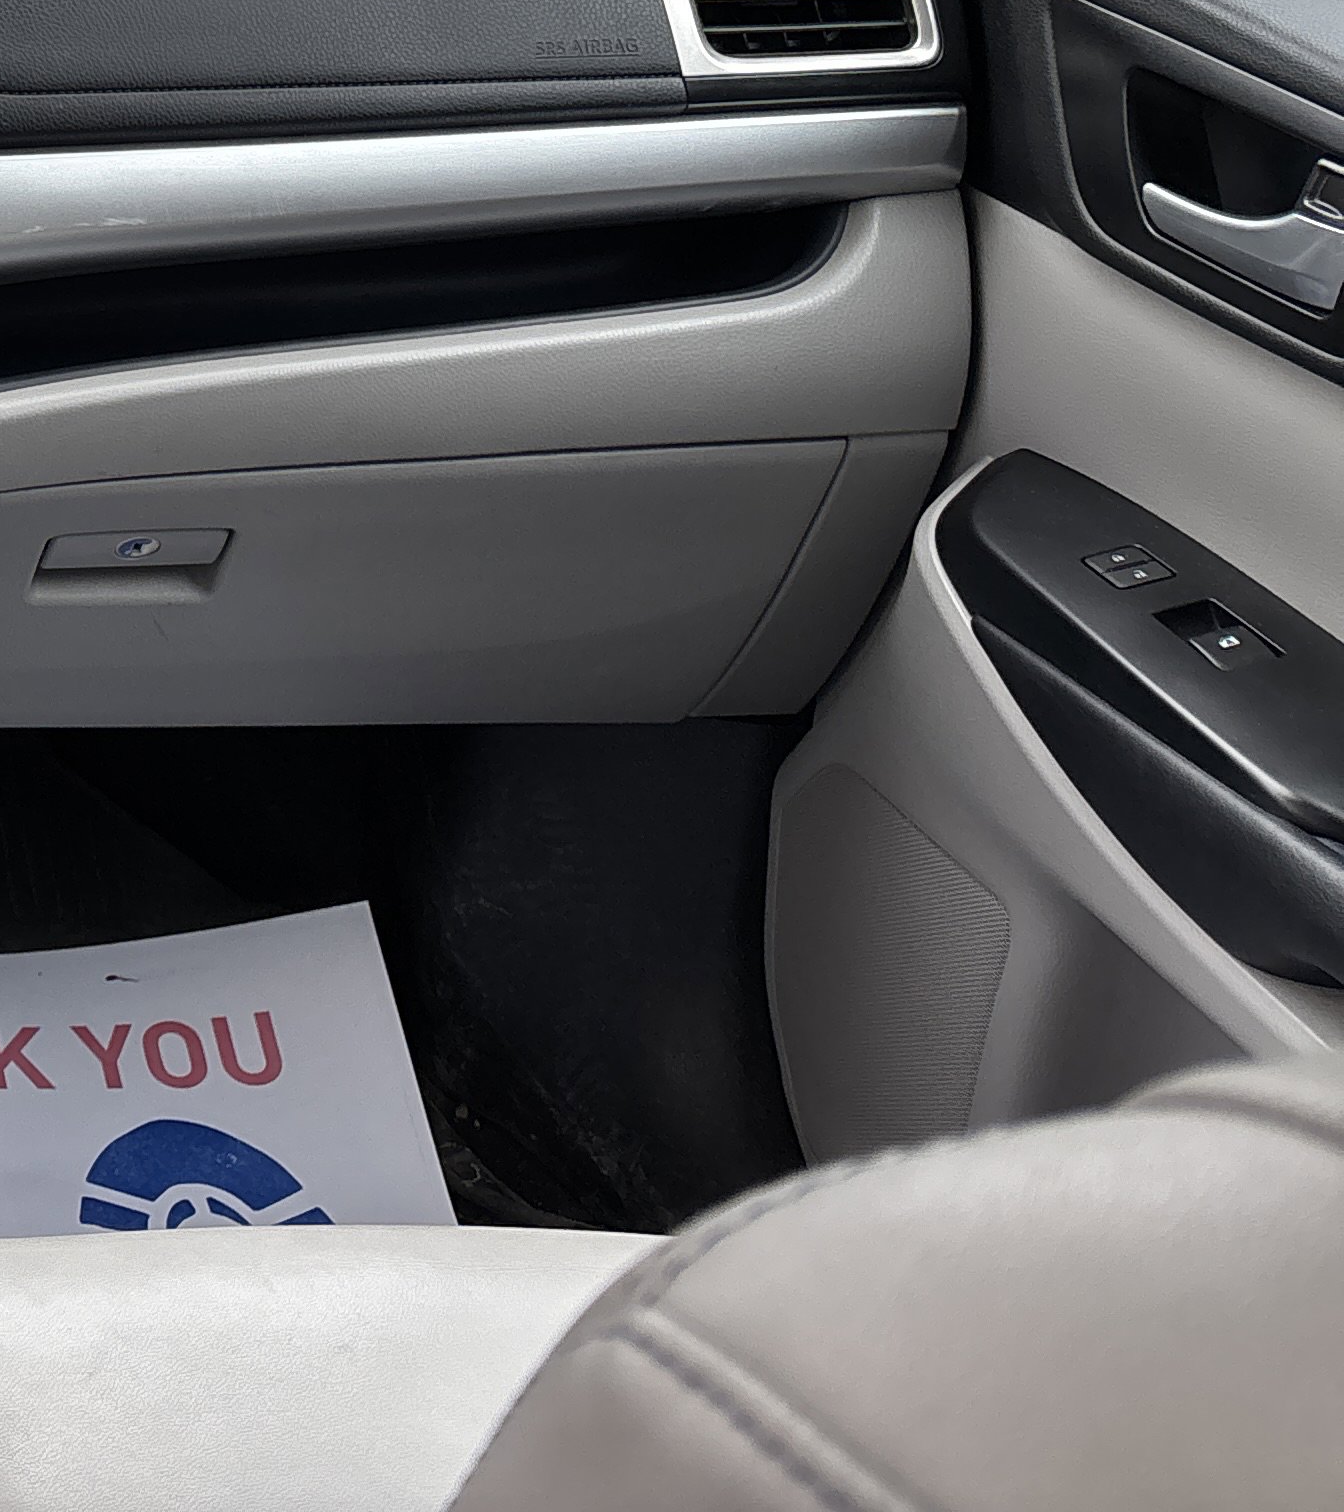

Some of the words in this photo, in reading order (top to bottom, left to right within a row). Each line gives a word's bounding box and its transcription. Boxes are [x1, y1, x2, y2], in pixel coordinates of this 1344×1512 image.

[535, 40, 566, 56] SRS
[571, 38, 639, 55] AIRBAG
[69, 1010, 284, 1090] YOU
